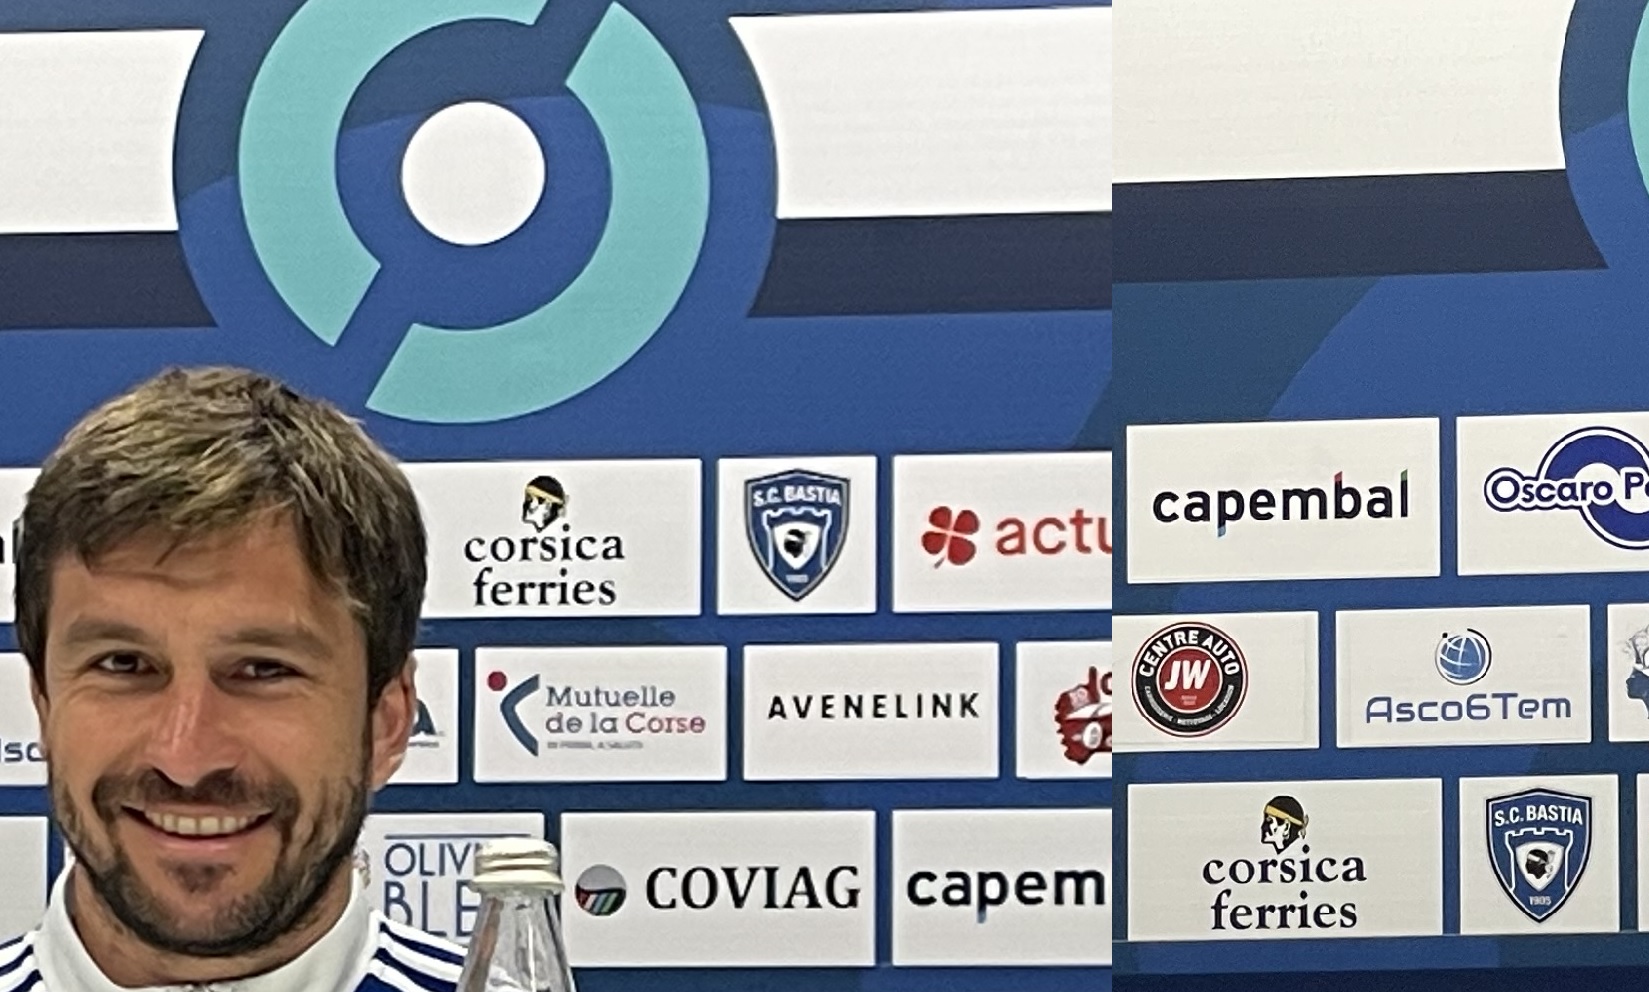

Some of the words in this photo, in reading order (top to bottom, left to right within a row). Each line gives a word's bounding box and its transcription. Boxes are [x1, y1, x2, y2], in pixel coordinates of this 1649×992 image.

[785, 486, 842, 506] BASTIA
[1153, 469, 1408, 537] capembal
[1490, 475, 1613, 502] Oscaro
[464, 524, 625, 562] corsica
[474, 568, 615, 607] ferries
[1139, 630, 1199, 677] CENTRE
[1202, 635, 1240, 675] AUTO
[1164, 660, 1211, 690] JW
[546, 686, 676, 707] Mutuelle
[768, 692, 979, 719] AVENELINK
[1366, 692, 1571, 724] Asco6Tem
[546, 713, 583, 733] de
[591, 712, 618, 733] la
[626, 712, 706, 734] Corse
[1494, 808, 1524, 826] S.C.
[1526, 805, 1584, 824] BASTIA
[1203, 845, 1367, 886] corsica
[646, 865, 861, 909] COVIAG
[1210, 890, 1358, 930] ferries
